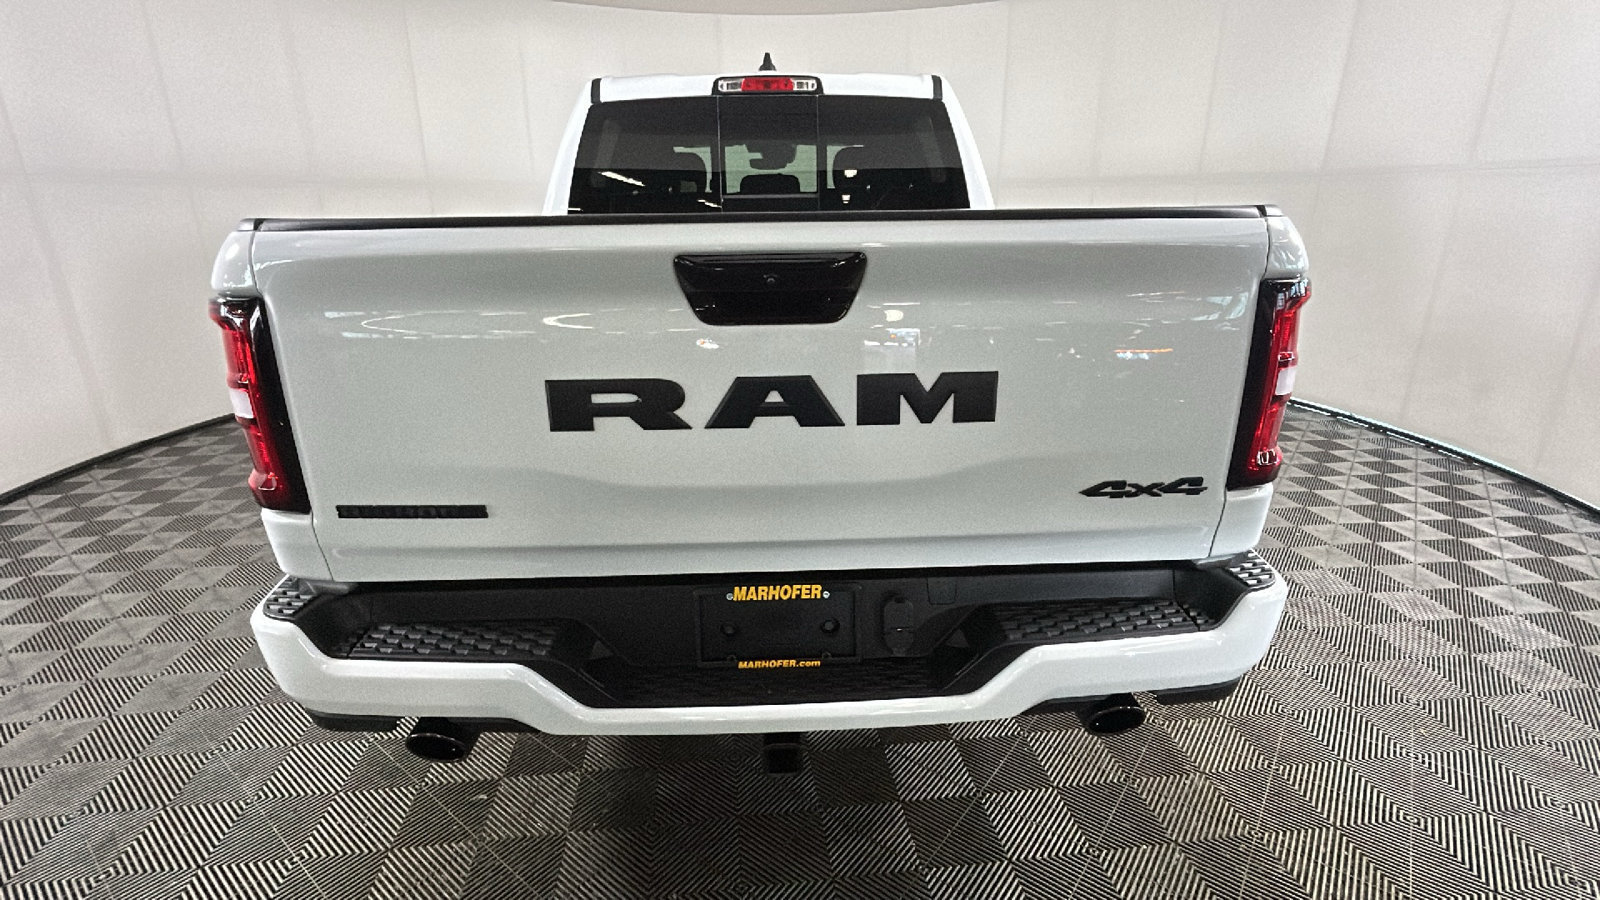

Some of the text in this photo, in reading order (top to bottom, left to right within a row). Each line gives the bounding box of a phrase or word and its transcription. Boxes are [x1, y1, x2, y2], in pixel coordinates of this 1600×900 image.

[545, 371, 998, 432] RAM
[733, 584, 822, 601] MARHOFER
[738, 659, 821, 669] MARHOFER.com
